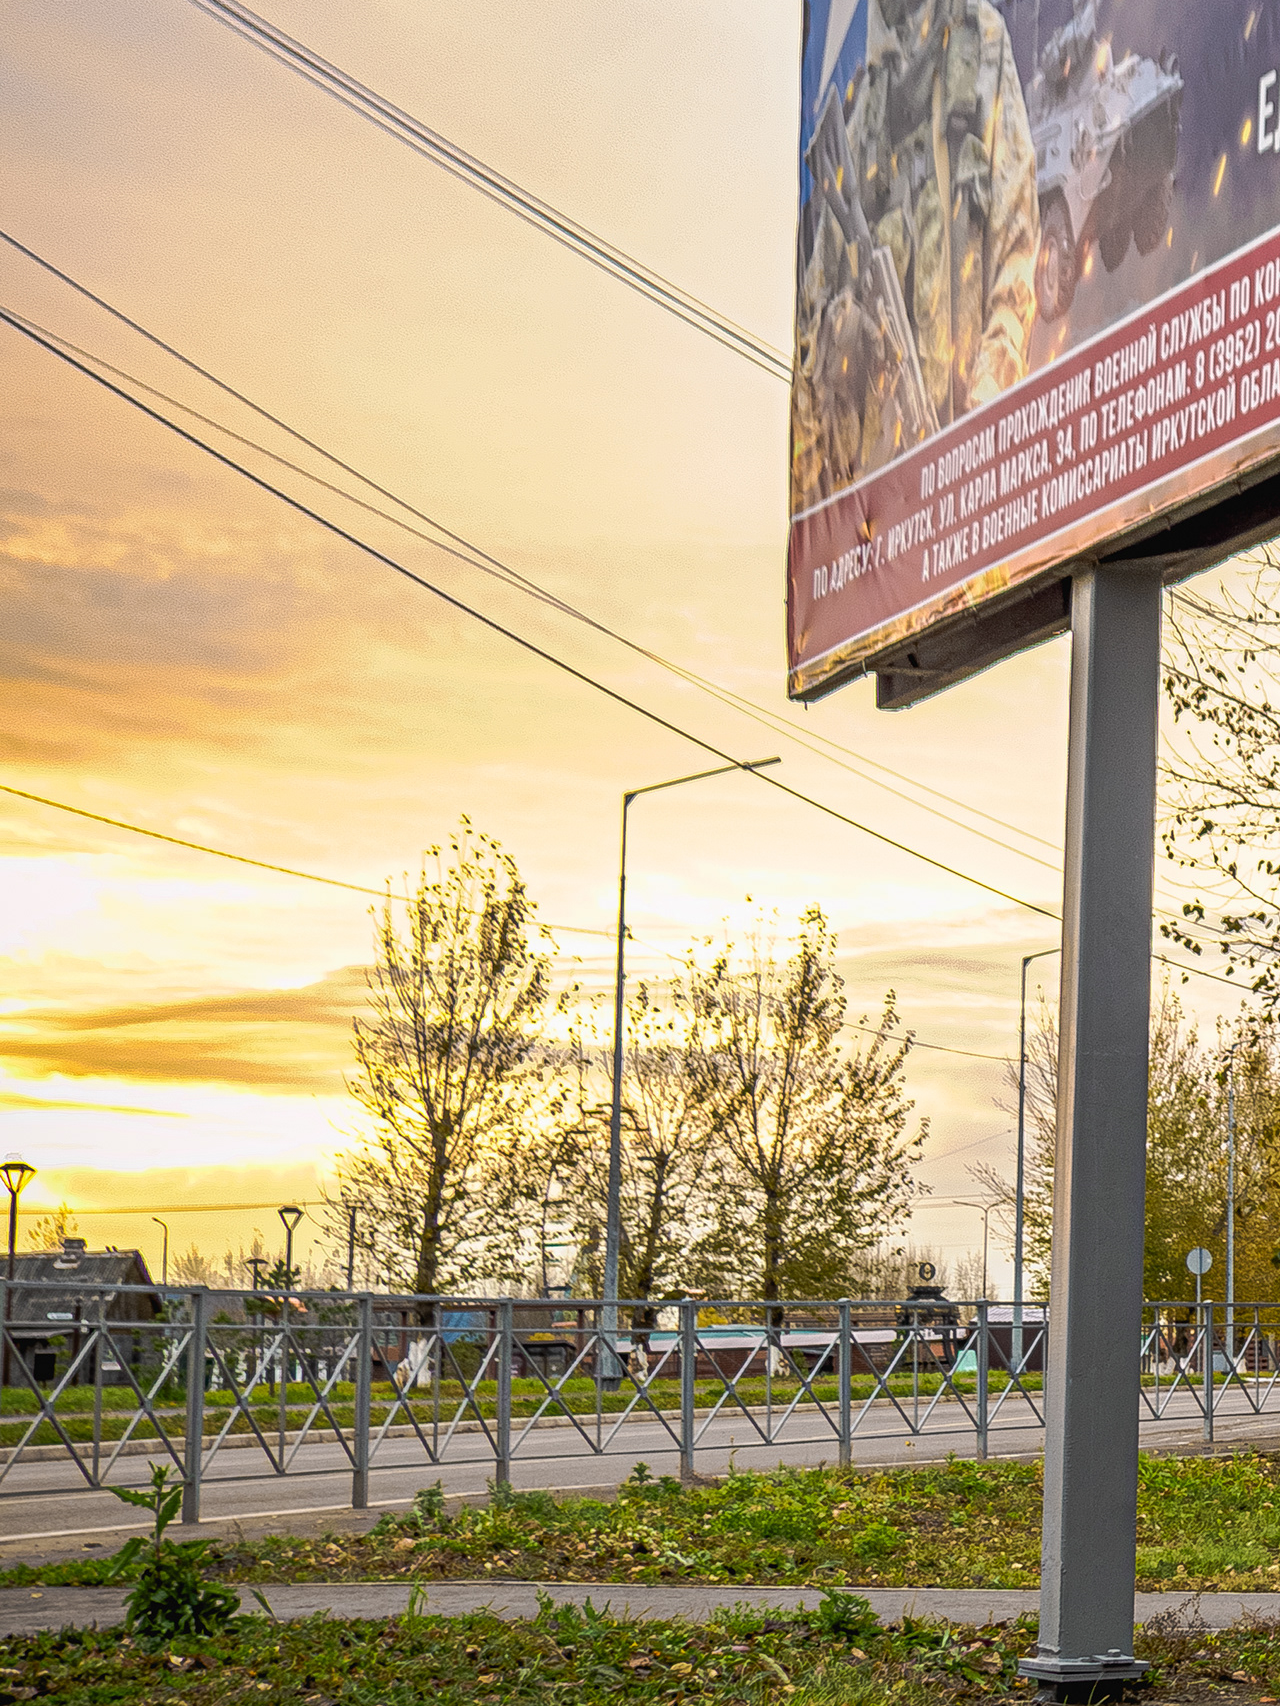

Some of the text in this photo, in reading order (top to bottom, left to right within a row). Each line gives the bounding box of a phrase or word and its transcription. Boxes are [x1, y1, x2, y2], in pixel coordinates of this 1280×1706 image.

[813, 564, 828, 601] ПО
[888, 504, 936, 562] ИРКУТСК,
[939, 493, 957, 531] УЛ.
[960, 469, 997, 520] КАРЛА
[1000, 438, 1052, 497] МАРКСА,
[1056, 424, 1076, 465] 34,
[1080, 410, 1097, 453] ПО
[1101, 359, 1191, 441] ТЕЛЕФОНАМ:
[1195, 350, 1205, 389] 8
[1209, 318, 1261, 382] (3952)
[920, 462, 936, 500] ПО
[937, 424, 996, 487] ВОПРОСАМ
[998, 368, 1091, 454] ПРОХОЖДЕНИЯ
[1095, 321, 1157, 399] ВОЕННОЙ
[1160, 288, 1226, 362] СЛУЖБЫ
[1229, 276, 1250, 324] ПО
[922, 549, 930, 583] А
[933, 526, 969, 577] ТАКЖЕ
[971, 521, 980, 556] В
[982, 488, 1038, 549] ВОЕННЫЕ
[1042, 429, 1148, 519] КОМИССАРИАТЫ
[1152, 374, 1236, 461] ИРКУТСКОЙ
